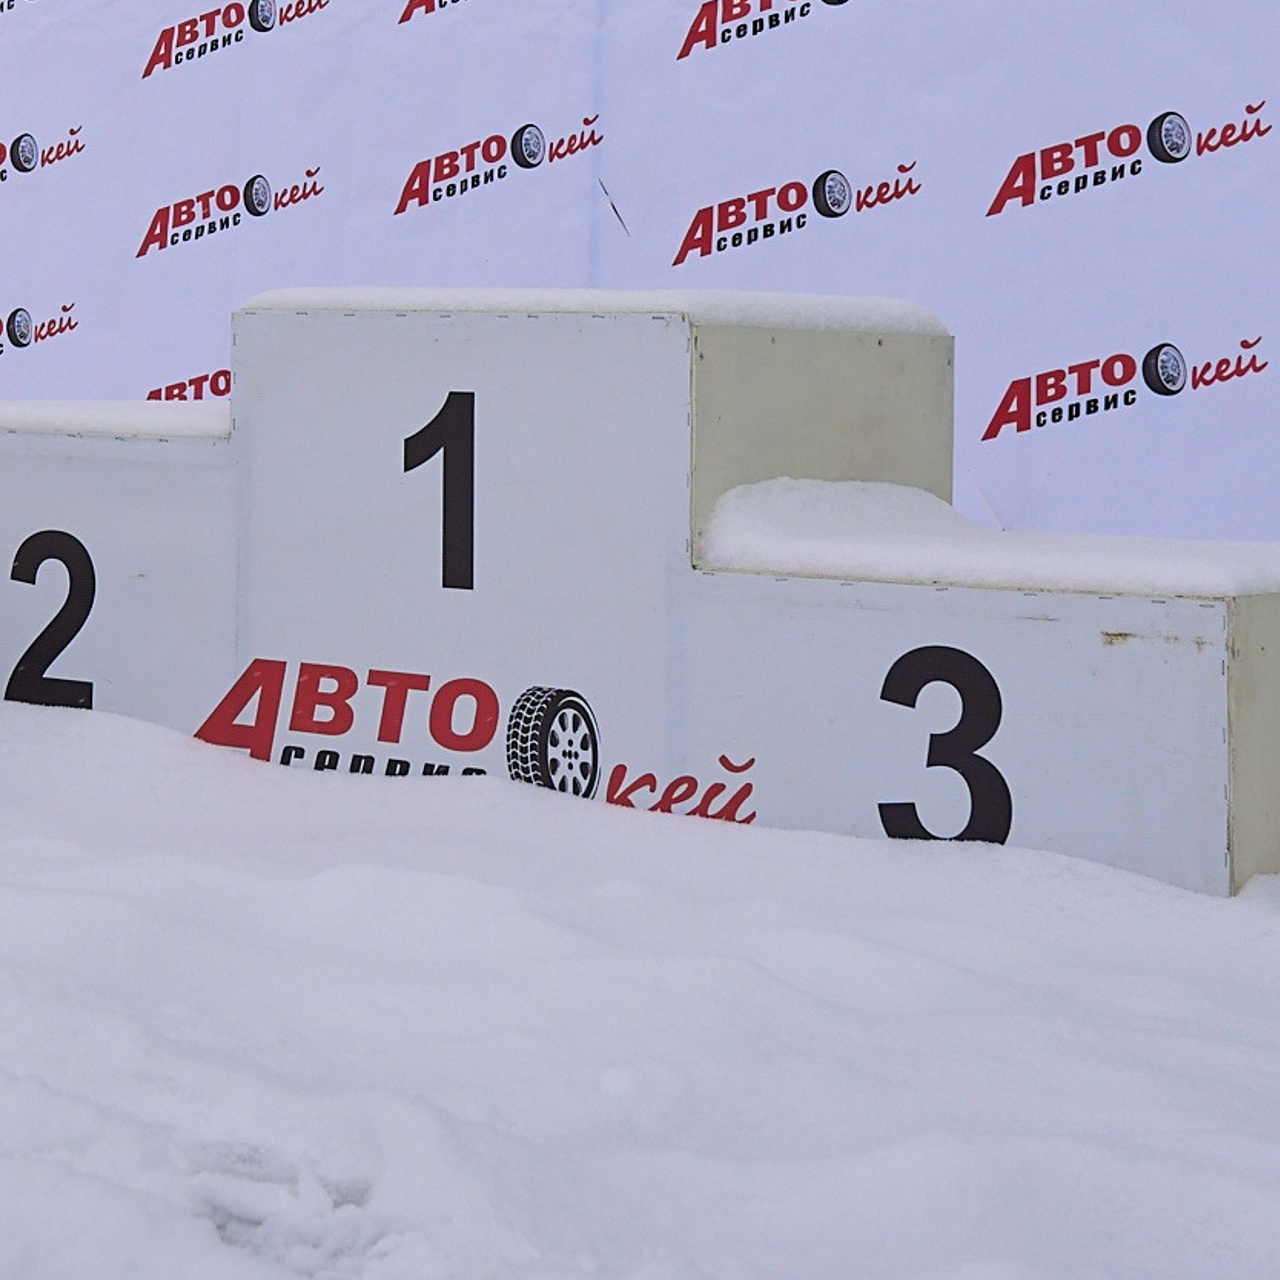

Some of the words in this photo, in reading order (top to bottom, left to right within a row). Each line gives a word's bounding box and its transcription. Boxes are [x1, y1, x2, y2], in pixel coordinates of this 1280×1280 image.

[144, 2, 246, 78] АВТО
[174, 29, 244, 65] сервис
[721, 2, 811, 44] сервис
[395, 134, 507, 215] АВТО
[432, 164, 507, 202] сервис
[987, 124, 1142, 216] АВТО
[1039, 159, 1142, 201] сервис
[137, 184, 241, 257] АВТО
[170, 212, 241, 246] сервис
[673, 181, 808, 266] АВТО
[716, 213, 807, 252] сервис
[982, 354, 1137, 440] АВТО
[1036, 389, 1137, 428] сервис
[403, 391, 475, 590] 1
[3, 529, 96, 709] 2
[193, 658, 500, 762] АВТО
[877, 645, 1013, 846] 3
